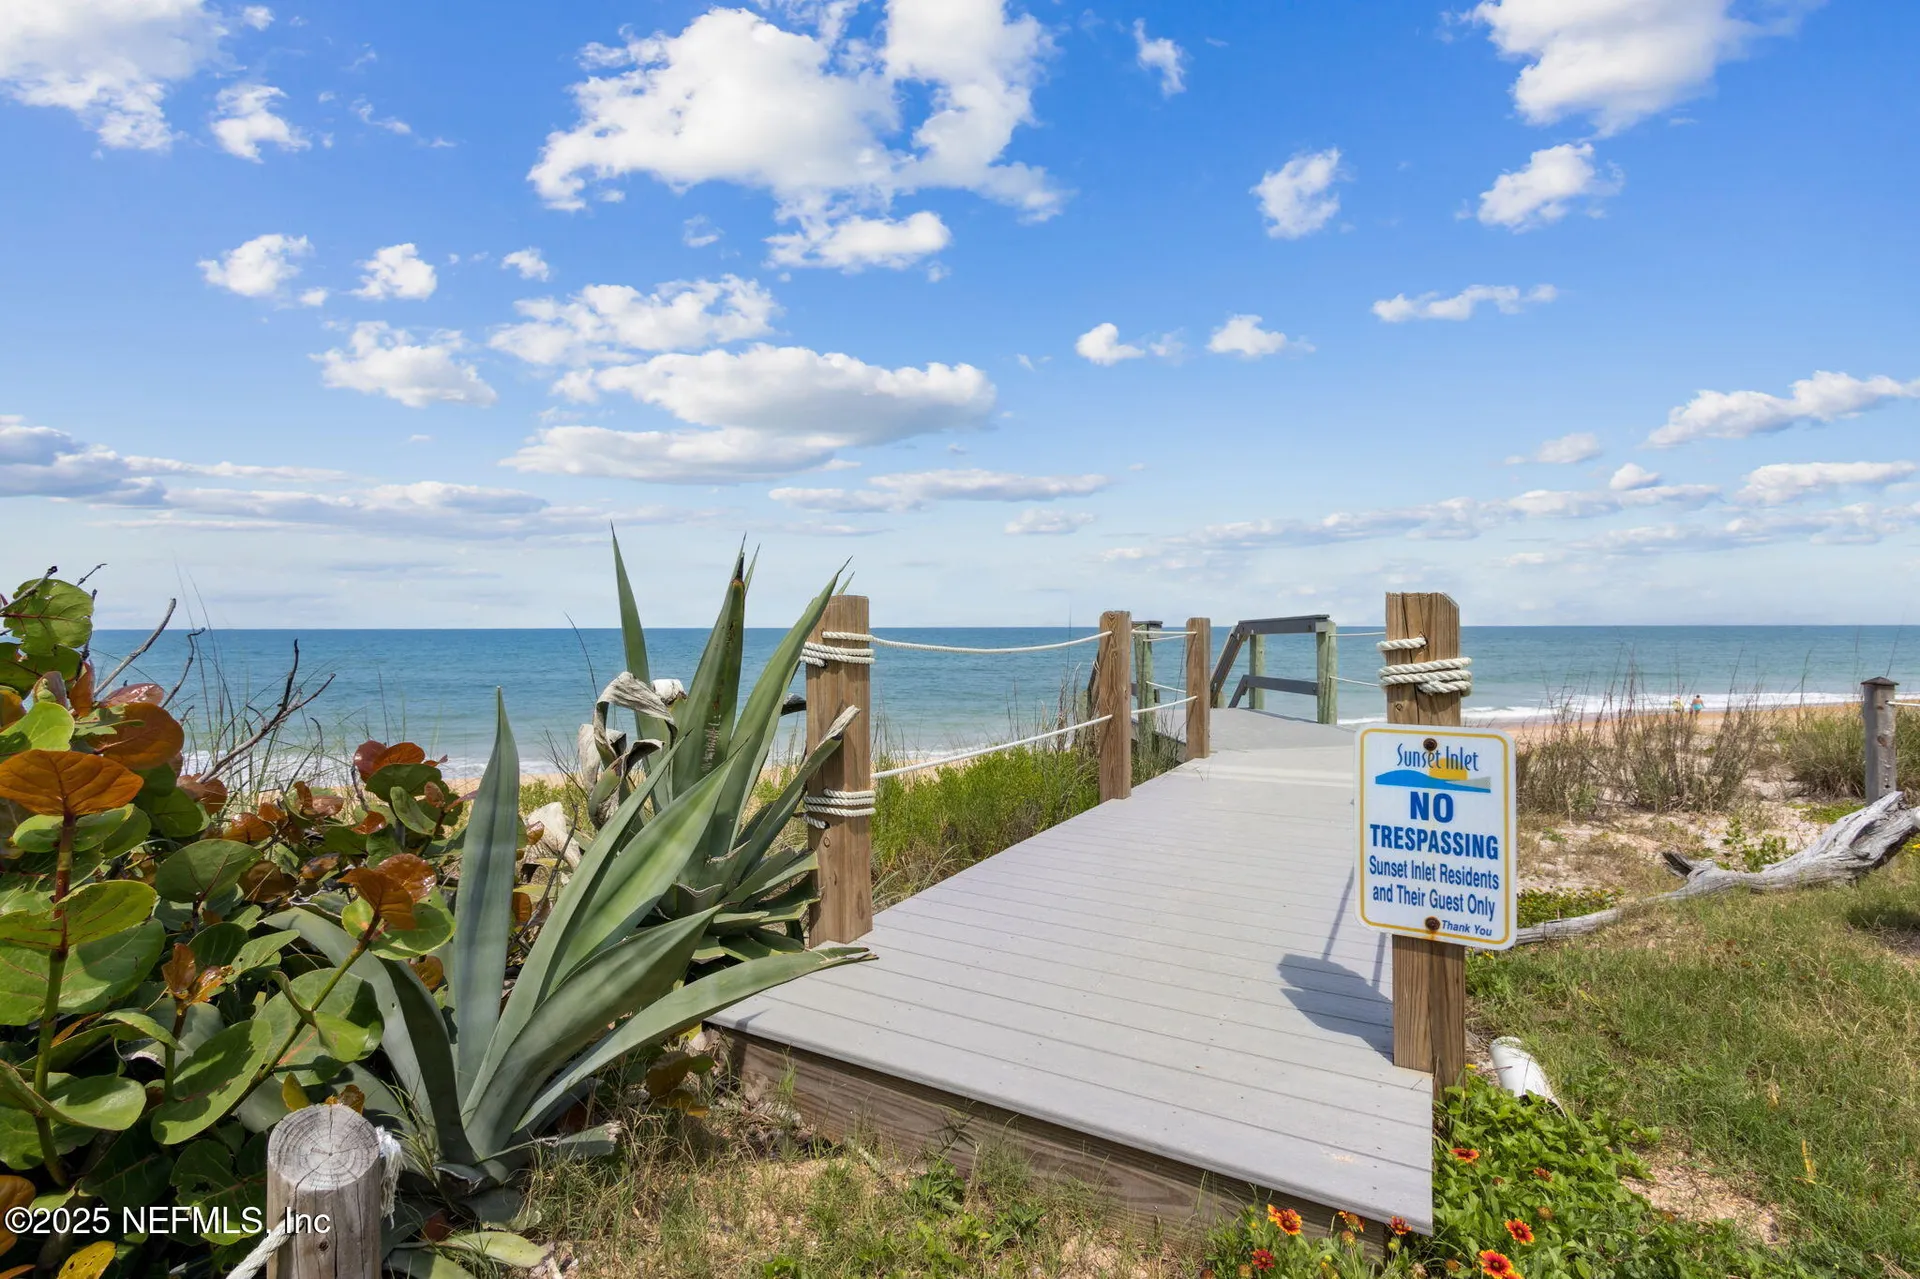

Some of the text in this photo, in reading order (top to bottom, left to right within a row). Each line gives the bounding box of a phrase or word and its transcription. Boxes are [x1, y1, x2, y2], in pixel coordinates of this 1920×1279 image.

[1397, 743, 1479, 771] Sunset Inlet
[1410, 791, 1454, 823] NO
[1369, 824, 1499, 860] TRESPASSING
[1369, 855, 1499, 890] Sunset Inlet Residents
[1372, 884, 1495, 922] and Their Guest Only
[1442, 920, 1492, 937] Thank You
